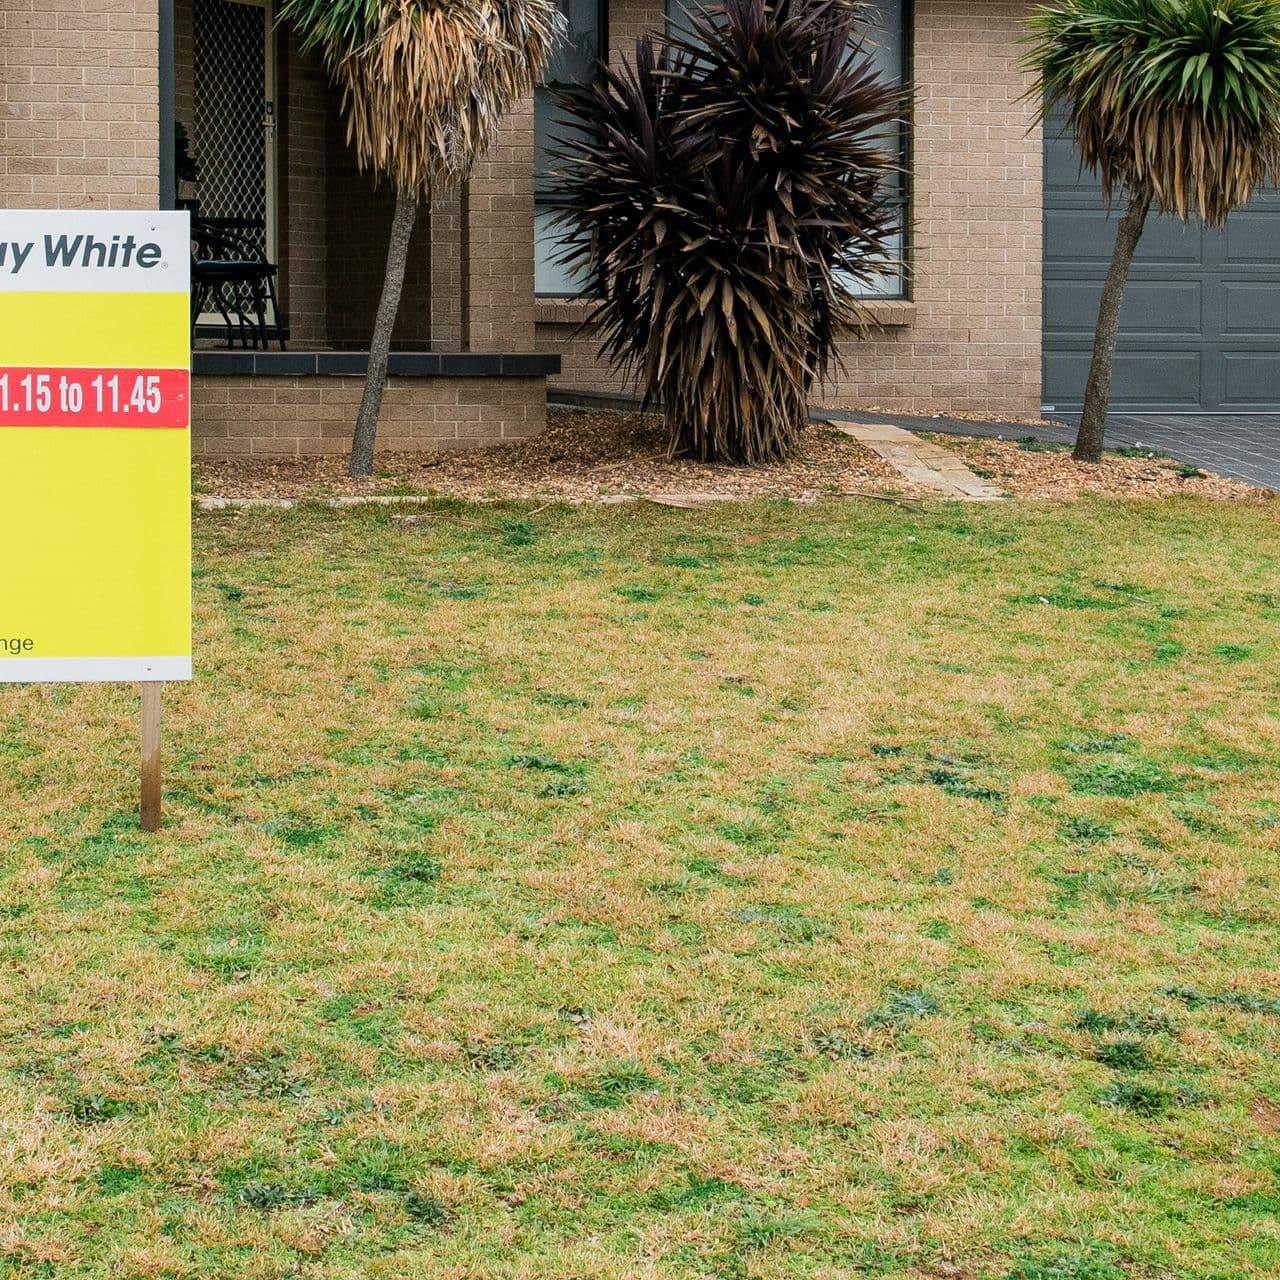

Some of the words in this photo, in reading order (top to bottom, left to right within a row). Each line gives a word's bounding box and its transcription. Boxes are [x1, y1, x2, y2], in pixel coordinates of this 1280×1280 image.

[43, 234, 162, 269] White
[58, 375, 83, 412] to
[91, 375, 162, 414] 11.45
